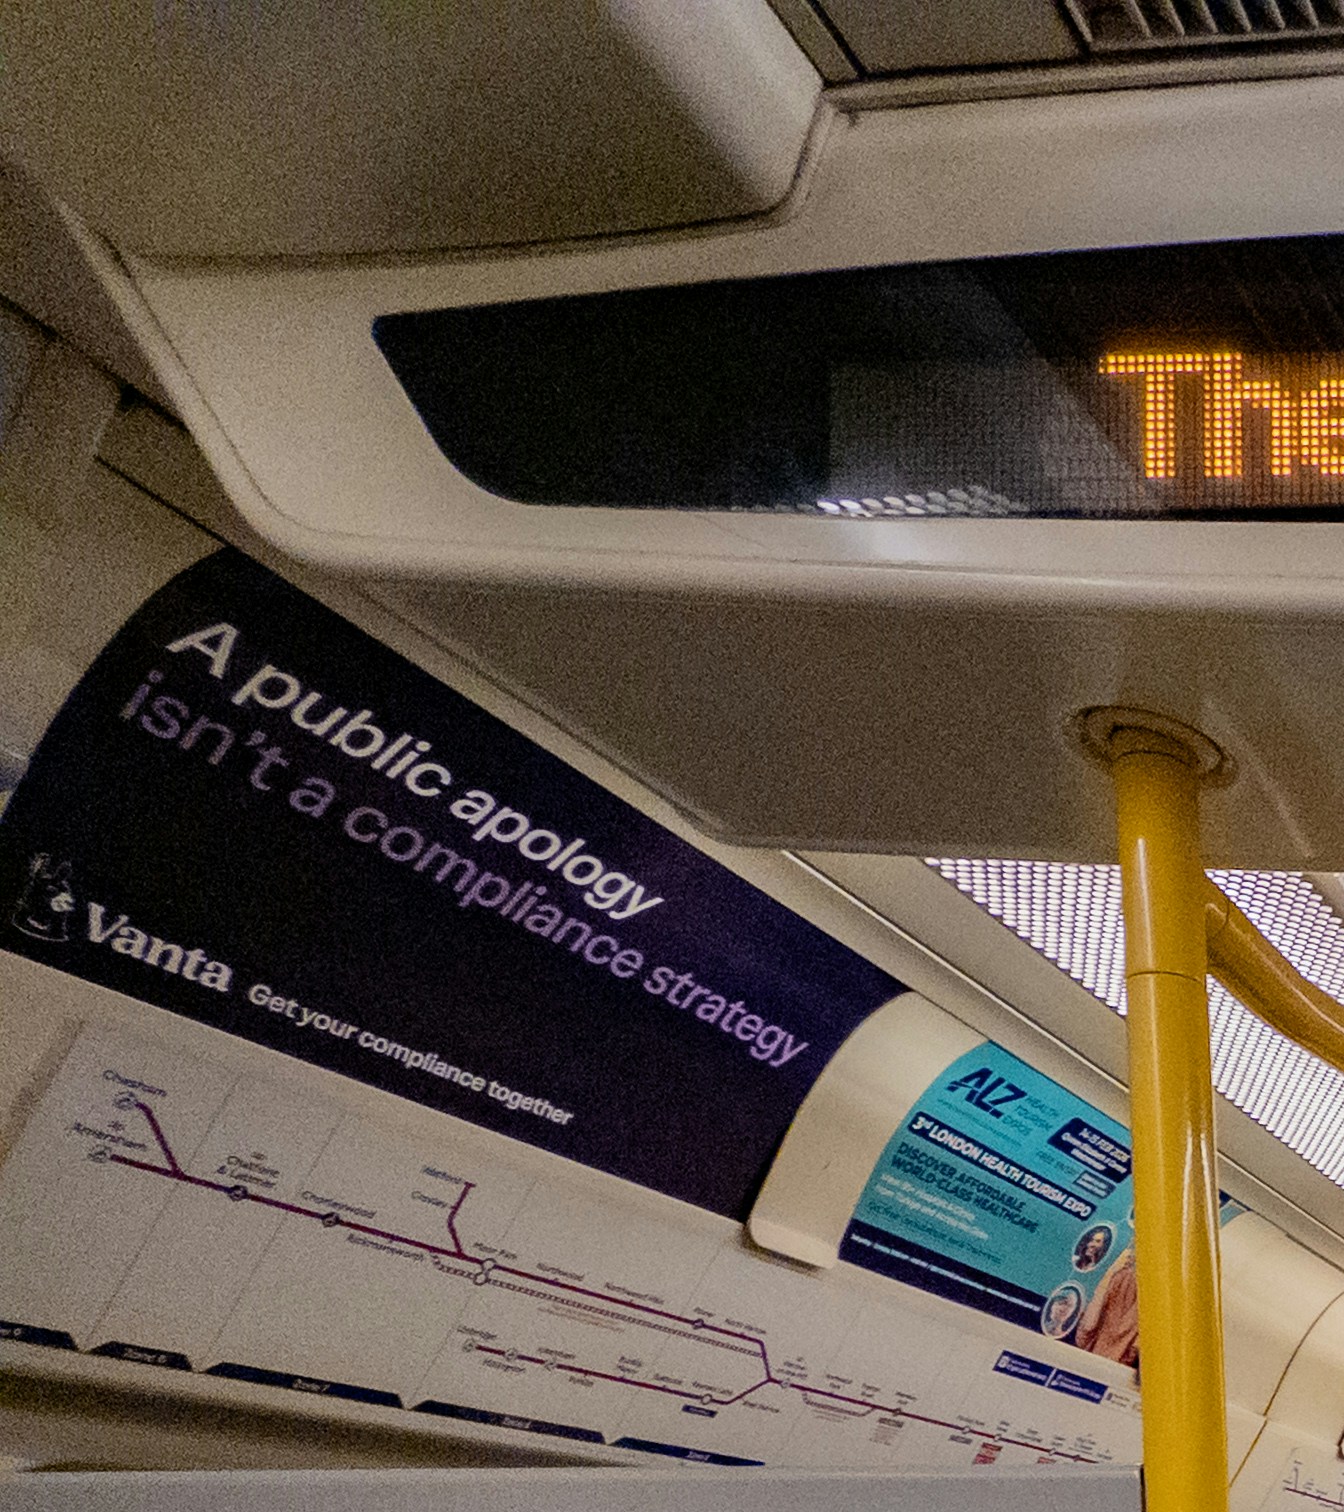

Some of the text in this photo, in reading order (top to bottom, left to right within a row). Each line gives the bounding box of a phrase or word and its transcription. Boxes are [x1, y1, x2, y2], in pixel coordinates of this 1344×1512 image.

[164, 622, 665, 921] A public apology
[118, 669, 811, 1068] isn't a compliance strategy
[86, 900, 234, 994] Vanta
[248, 983, 575, 1127] Get your compliance together
[946, 1067, 1028, 1120] ALZ
[897, 1141, 1026, 1213] DISCOVER AFFORDABLE
[929, 1122, 982, 1162] LONDON
[979, 1150, 1024, 1183] HEALTH
[1020, 1171, 1068, 1205] TOURISM
[1062, 1195, 1093, 1219] EXPO
[971, 1191, 1040, 1233] HEALTHCARE
